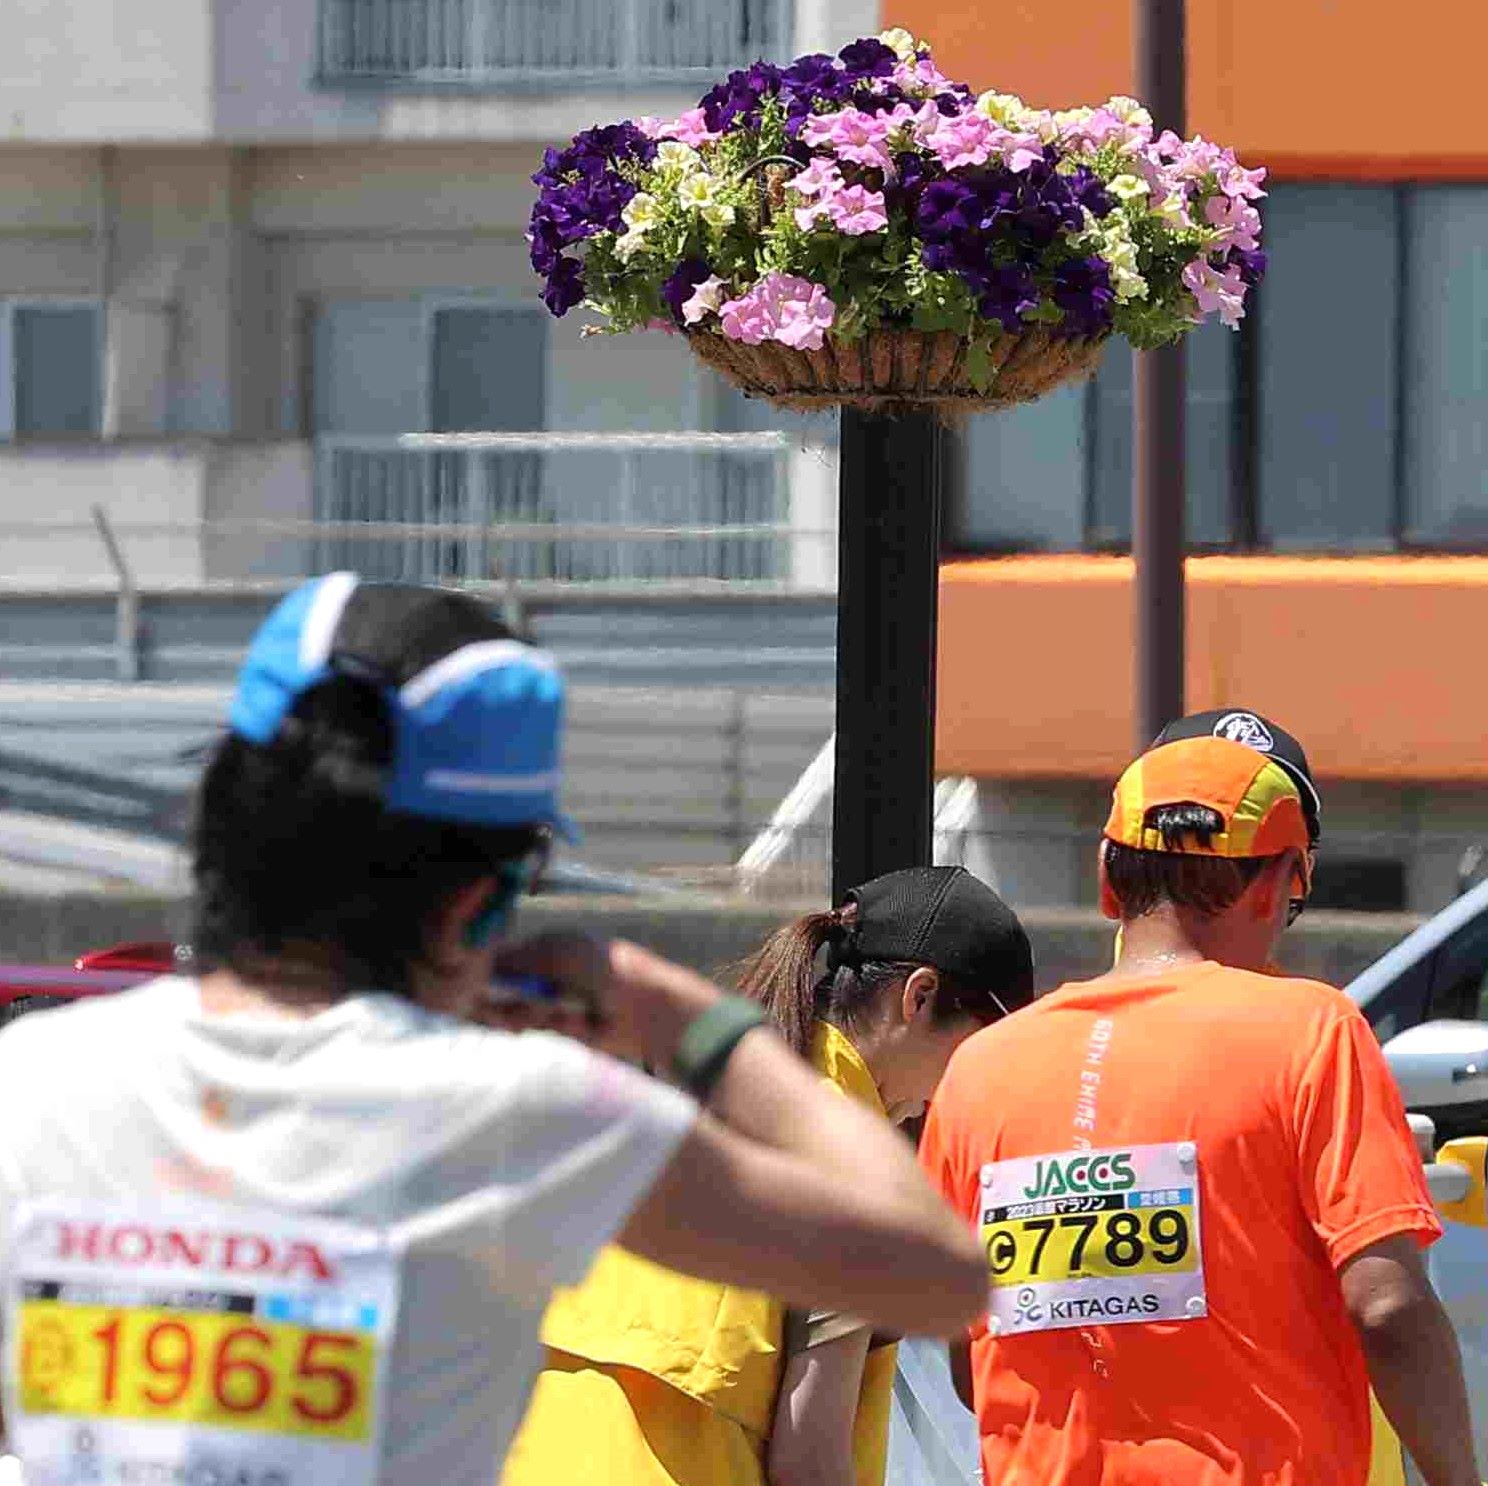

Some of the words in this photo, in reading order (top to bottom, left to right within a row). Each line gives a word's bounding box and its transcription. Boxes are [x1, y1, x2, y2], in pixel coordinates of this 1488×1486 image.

[1024, 1153, 1136, 1199] JACCS
[58, 1222, 334, 1280] HONDA
[1023, 1209, 1189, 1275] 7789
[1050, 1294, 1160, 1319] KITAGAS
[92, 1312, 360, 1424] 1965
